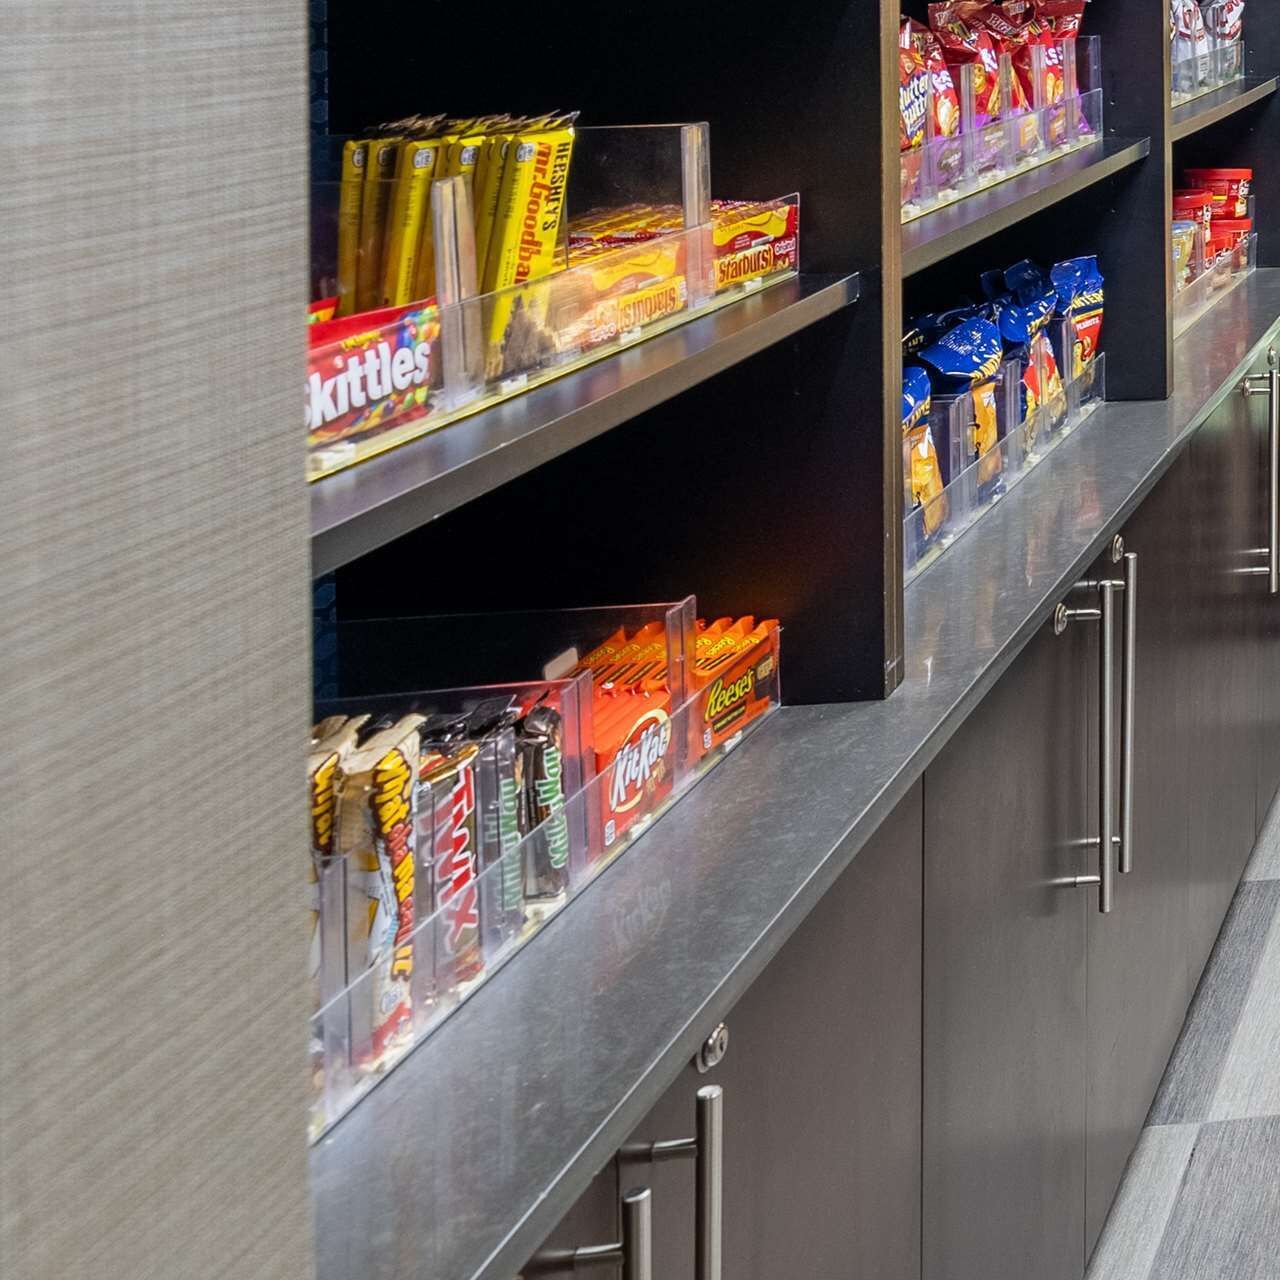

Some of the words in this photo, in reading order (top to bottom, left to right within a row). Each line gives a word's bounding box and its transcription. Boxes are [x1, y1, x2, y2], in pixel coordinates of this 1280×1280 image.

[542, 141, 570, 232] HERSHEY'S
[718, 243, 774, 281] Starburst
[304, 341, 431, 431] kittles
